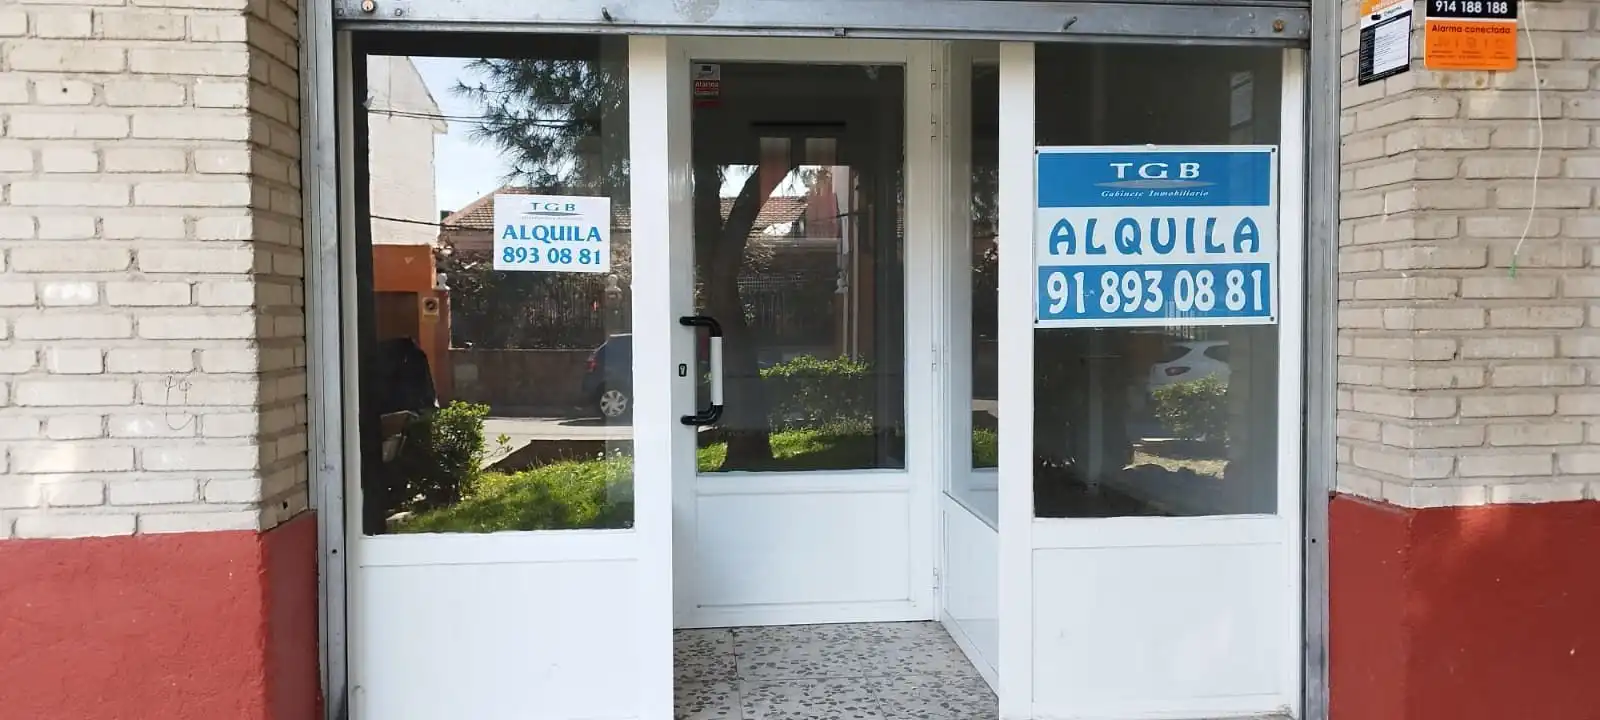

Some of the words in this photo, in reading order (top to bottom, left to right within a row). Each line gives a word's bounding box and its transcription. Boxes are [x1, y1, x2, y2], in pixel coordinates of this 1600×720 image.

[1435, 0, 1456, 13] 914
[1461, 1, 1482, 13] 188
[1487, 2, 1508, 14] 188
[1431, 24, 1463, 33] Alarma
[1464, 25, 1511, 34] conectada
[1101, 190, 1144, 198] Gabinete
[1148, 189, 1209, 197] Inmobiliario
[502, 224, 602, 244] ALQUILA
[1048, 216, 1260, 256] ALQUILA
[502, 246, 540, 263] 893
[547, 247, 572, 264] 08
[578, 248, 600, 265] 81
[1046, 271, 1086, 314] 91
[1099, 270, 1164, 314] 893
[1173, 269, 1216, 312] 08
[1225, 269, 1263, 312] 81
